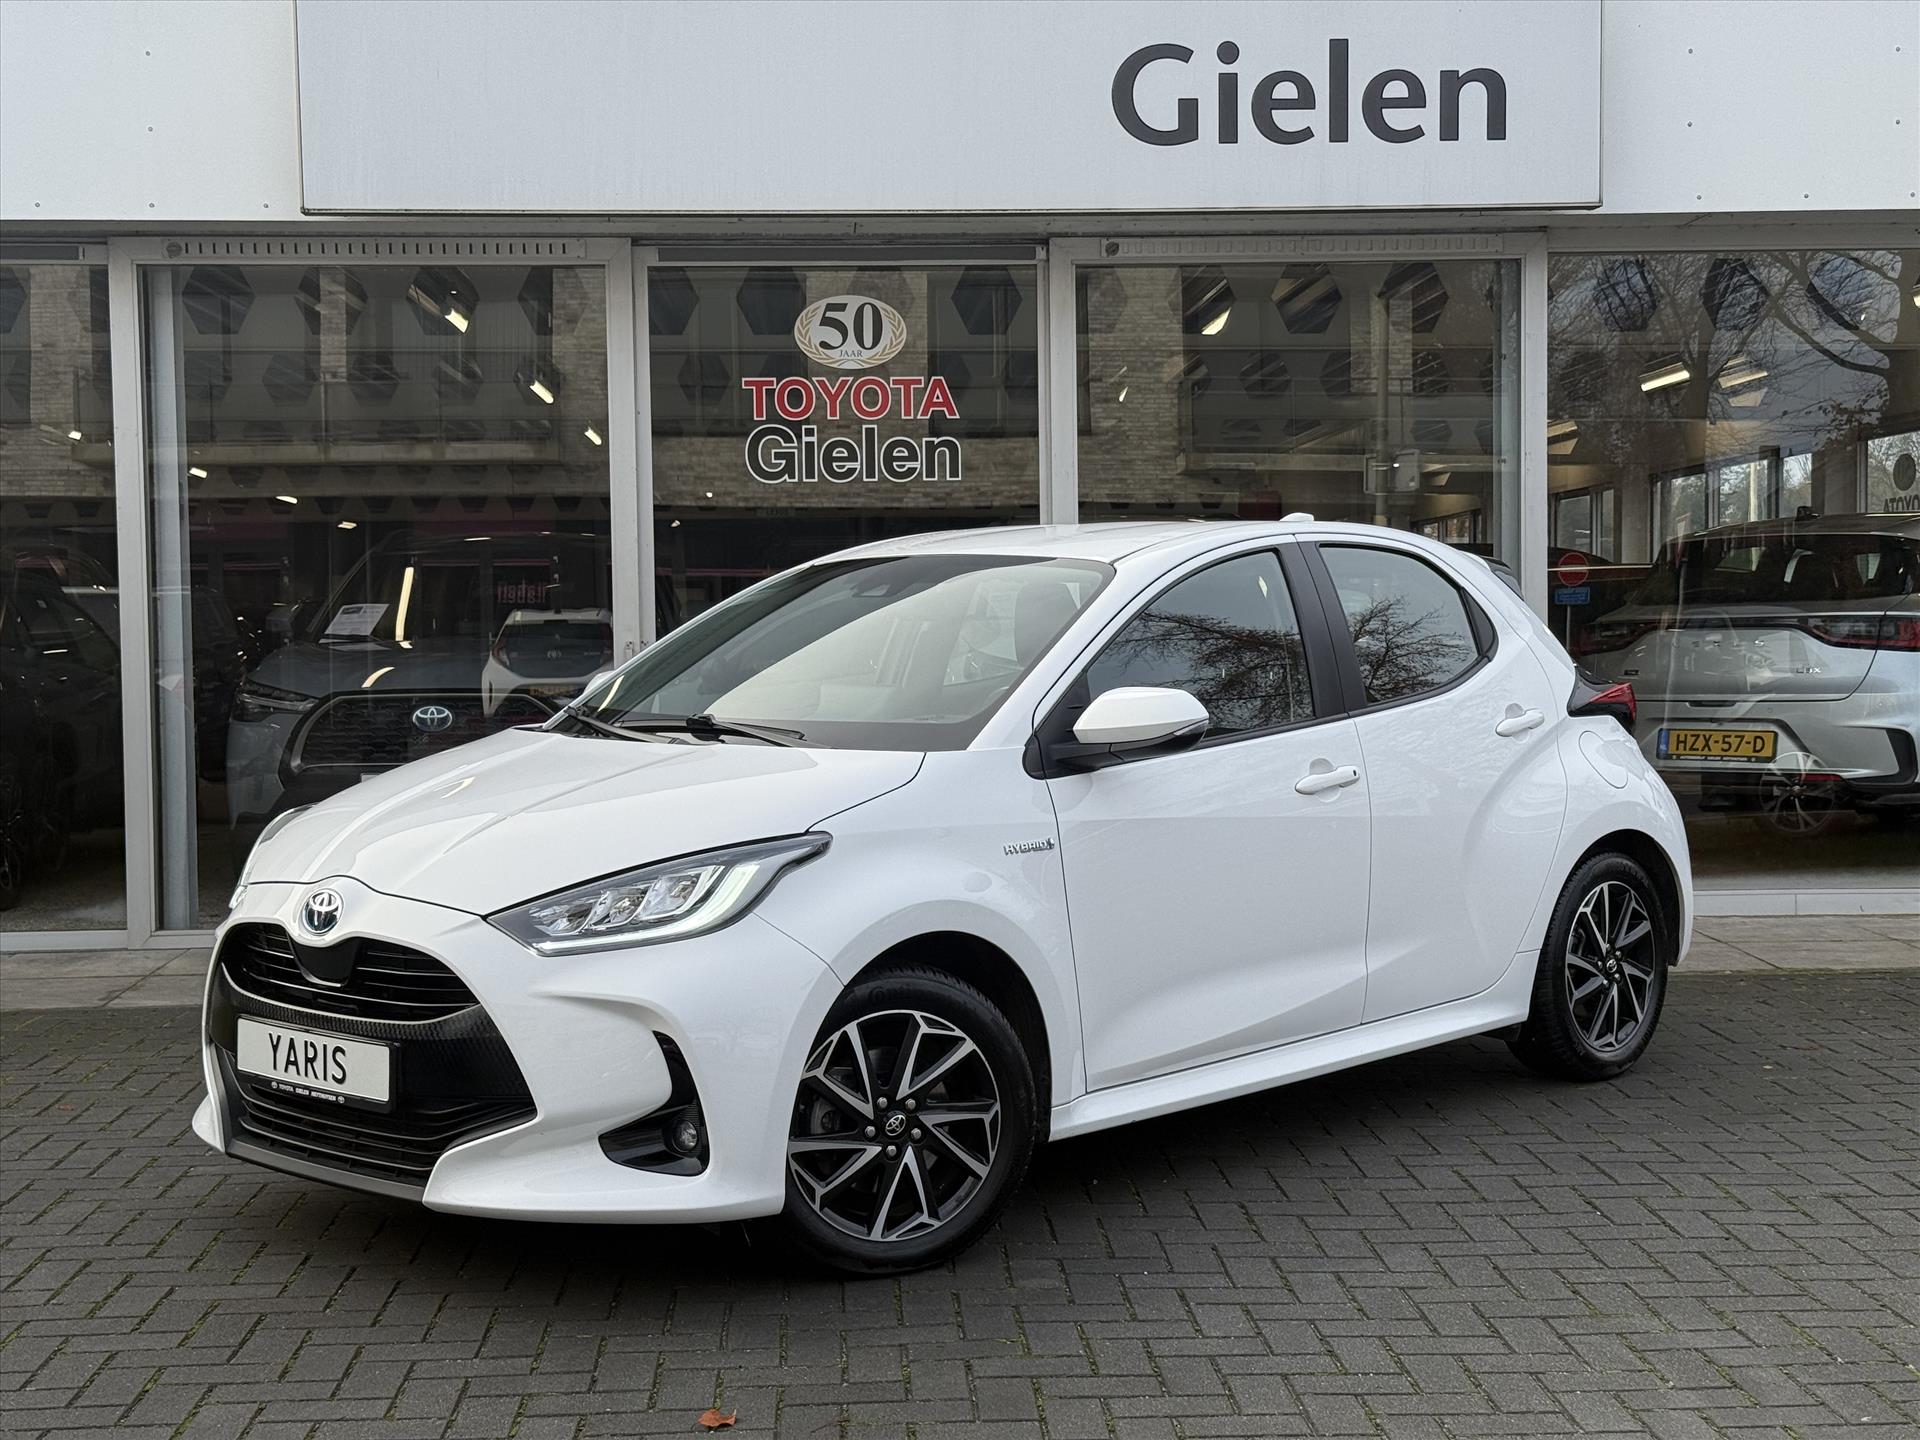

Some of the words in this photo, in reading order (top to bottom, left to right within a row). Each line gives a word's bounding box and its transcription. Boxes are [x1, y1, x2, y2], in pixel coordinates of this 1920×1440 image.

[1111, 38, 1507, 146] Gielen
[818, 302, 883, 350] 50
[839, 349, 863, 358] JAAR
[741, 376, 960, 421] TOYOTA
[745, 424, 962, 483] Gielen
[1675, 733, 1766, 754] HZX-57-D
[1003, 840, 1049, 856] HYBRID
[268, 1032, 347, 1085] YARIS
